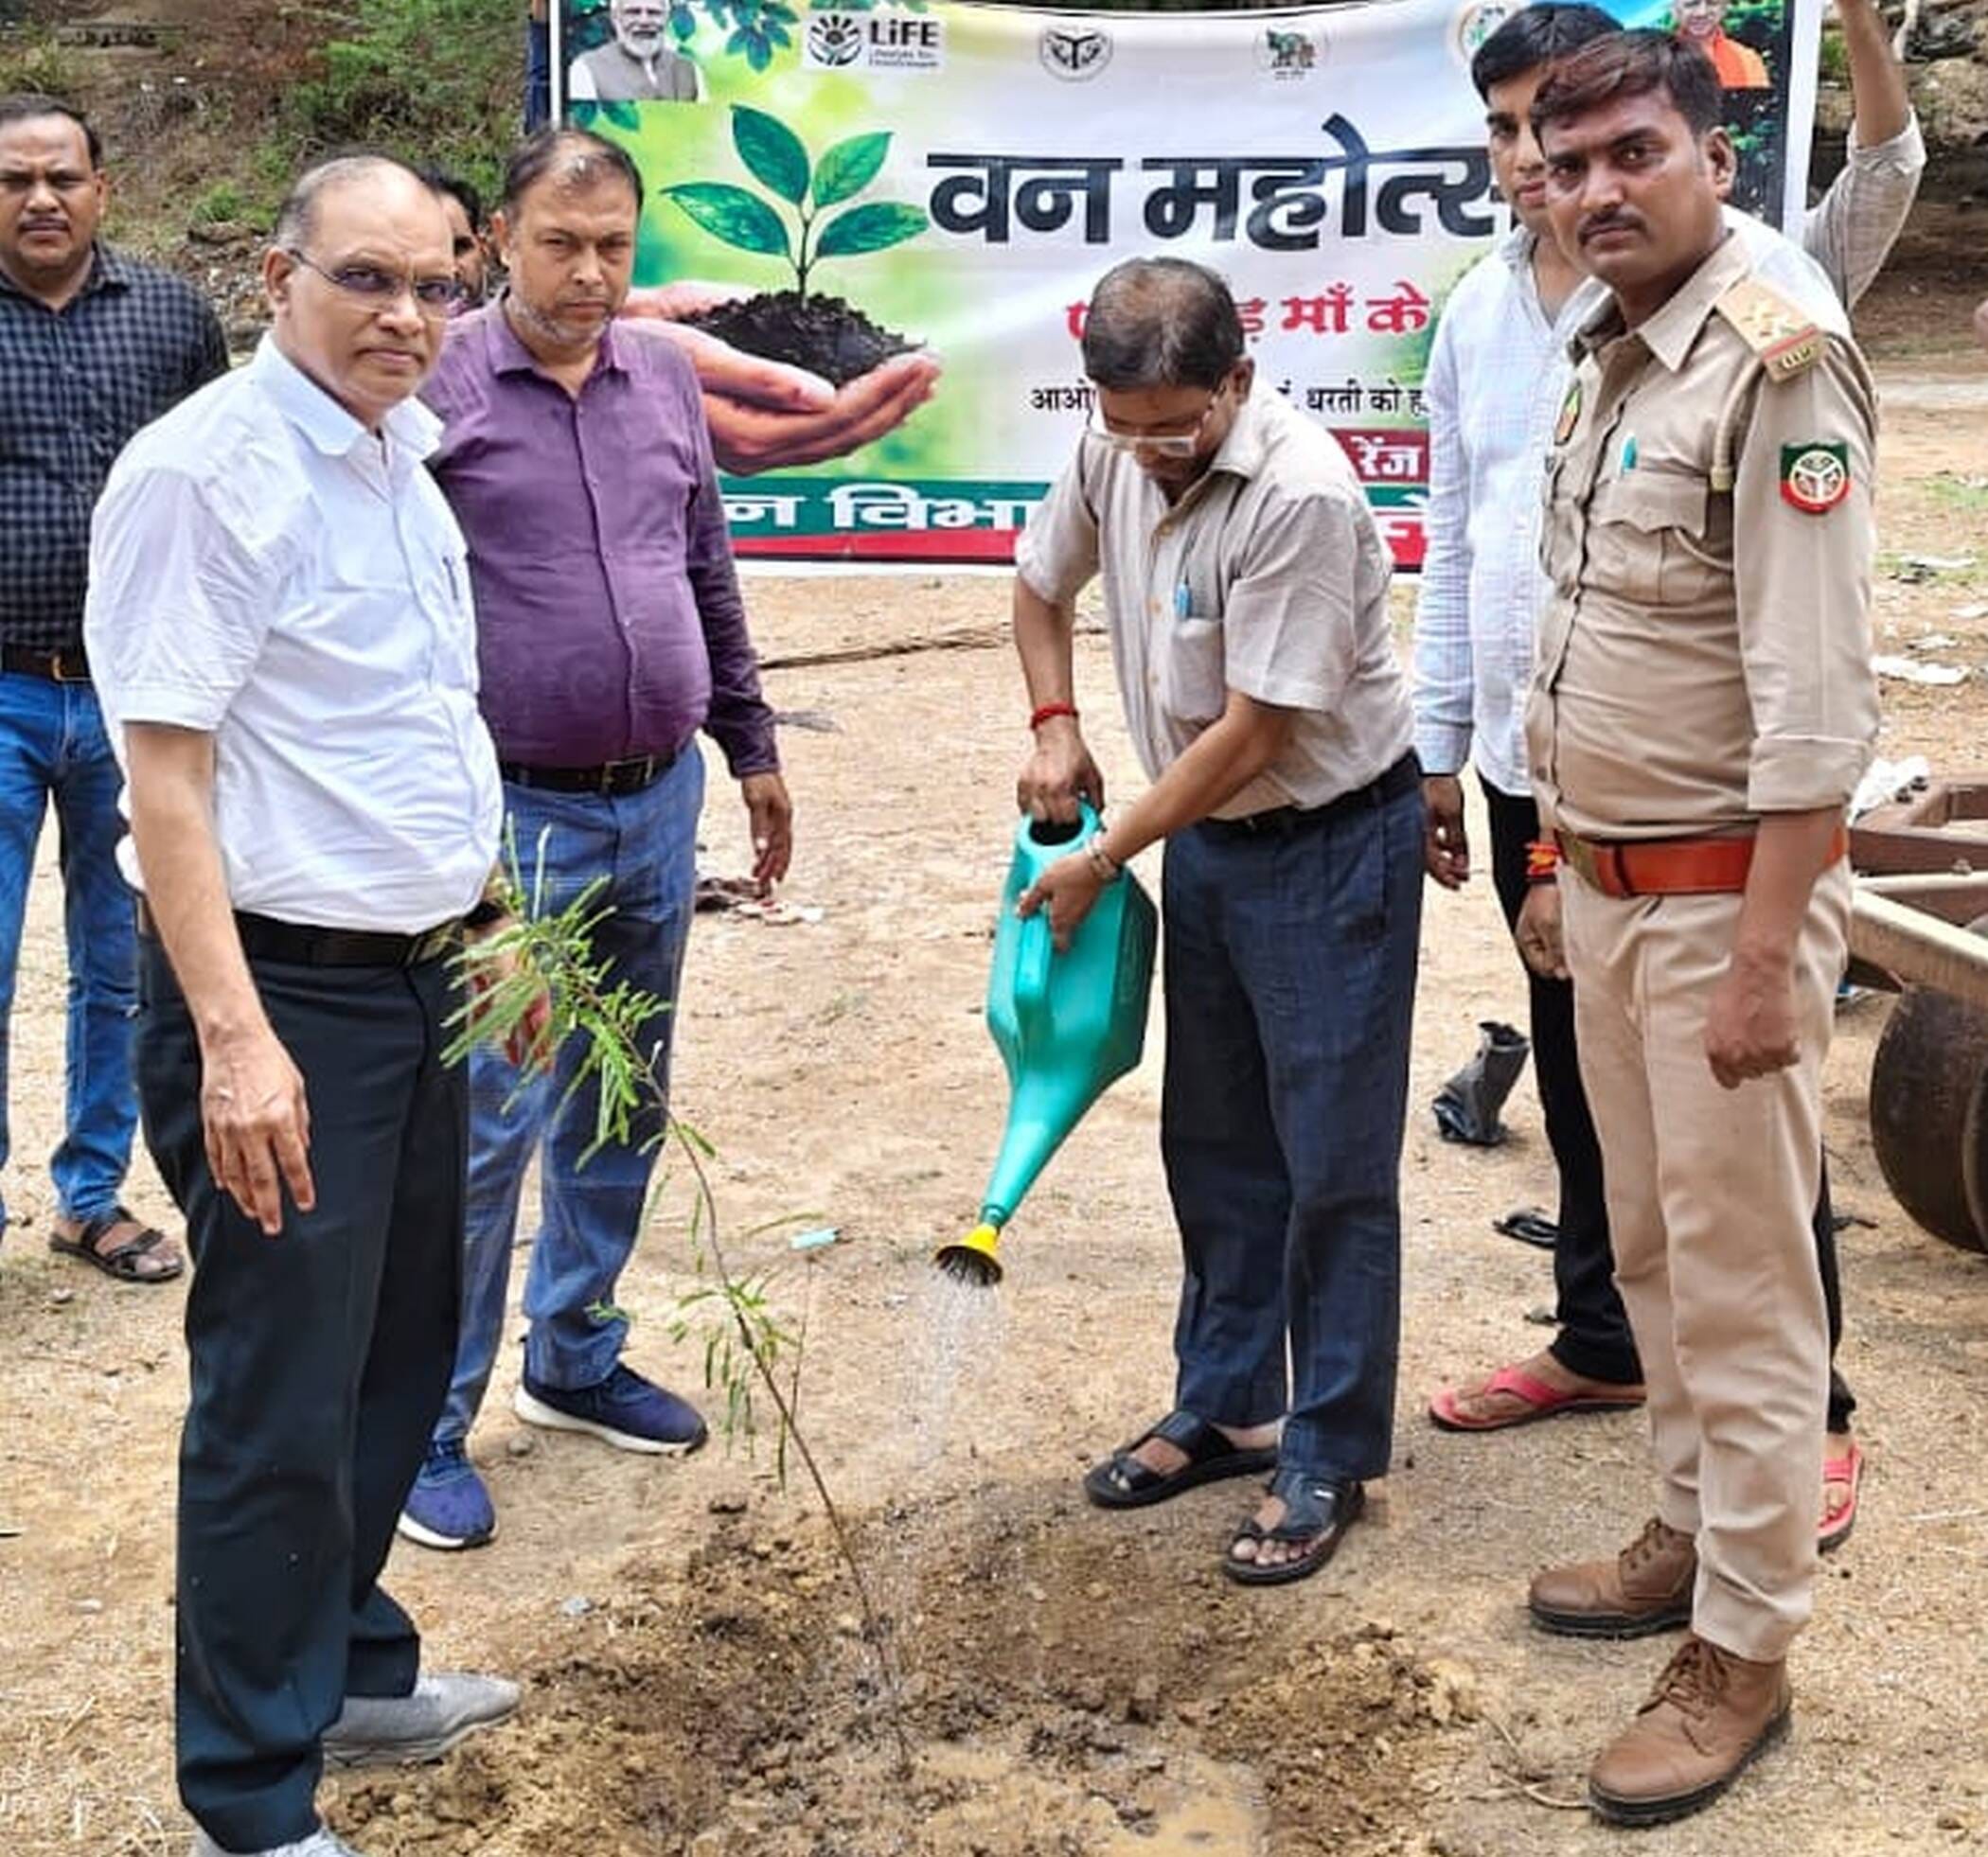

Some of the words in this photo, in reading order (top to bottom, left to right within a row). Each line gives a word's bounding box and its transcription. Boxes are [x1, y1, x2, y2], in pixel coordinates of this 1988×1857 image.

[870, 19, 938, 45] LiFE
[927, 153, 1124, 243] वन
[1281, 282, 1354, 333] माँ
[1368, 281, 1429, 333] के
[1306, 379, 1363, 413] धरती
[1369, 379, 1403, 412] को
[1350, 436, 1424, 477] रेंज
[823, 483, 1044, 531] विभा
